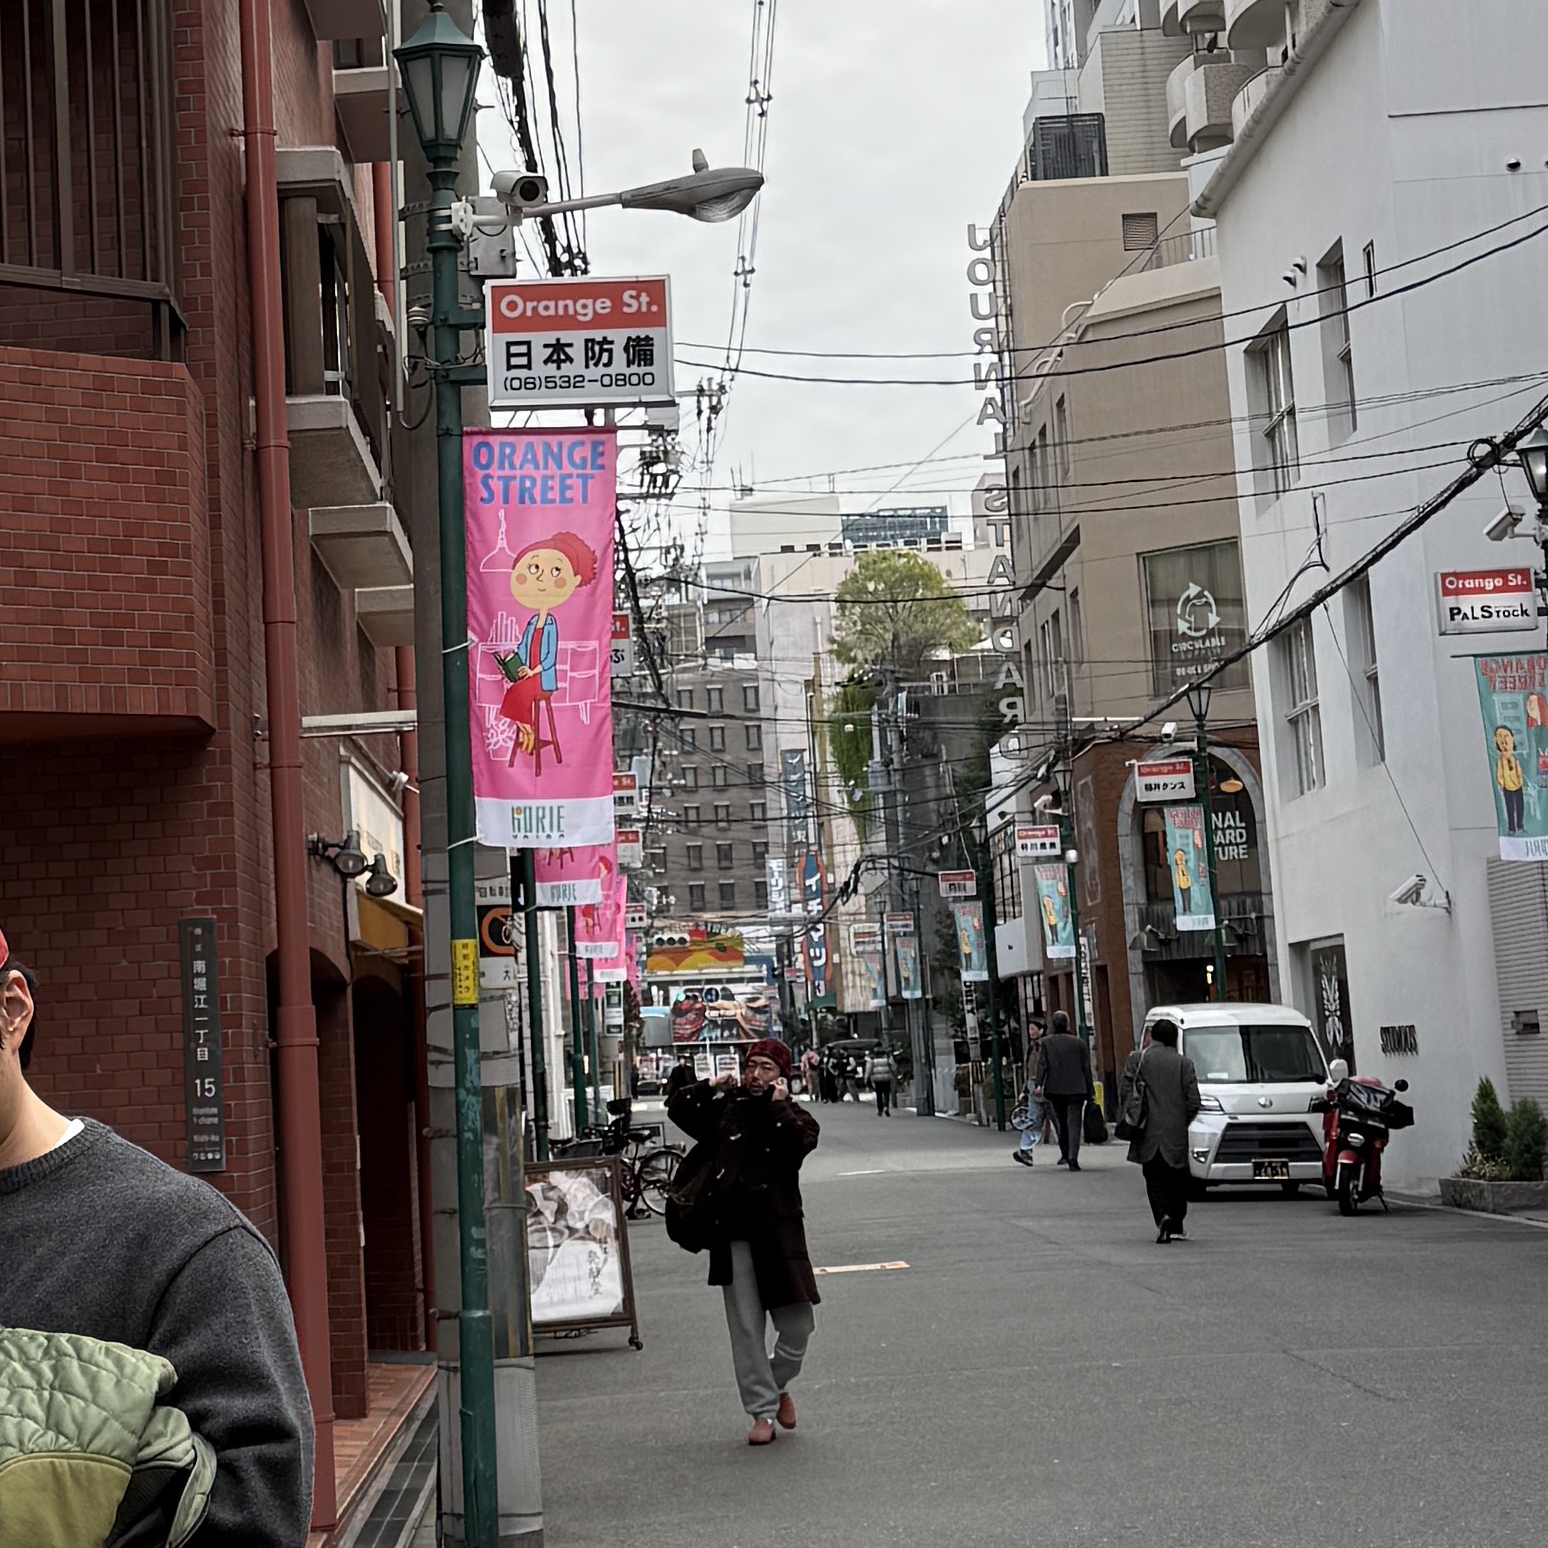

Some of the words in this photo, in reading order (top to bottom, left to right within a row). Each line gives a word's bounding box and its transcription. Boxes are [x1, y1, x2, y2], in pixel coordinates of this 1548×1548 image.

[500, 289, 612, 322] Orange
[622, 289, 658, 314] St.
[505, 335, 655, 372] 日本防備
[503, 372, 655, 391] (06)532-0800
[472, 440, 605, 472] ORANGE
[479, 472, 594, 505] STREET
[1445, 576, 1503, 591] Orange
[511, 804, 565, 834] HORIE
[194, 1078, 216, 1098] 15
